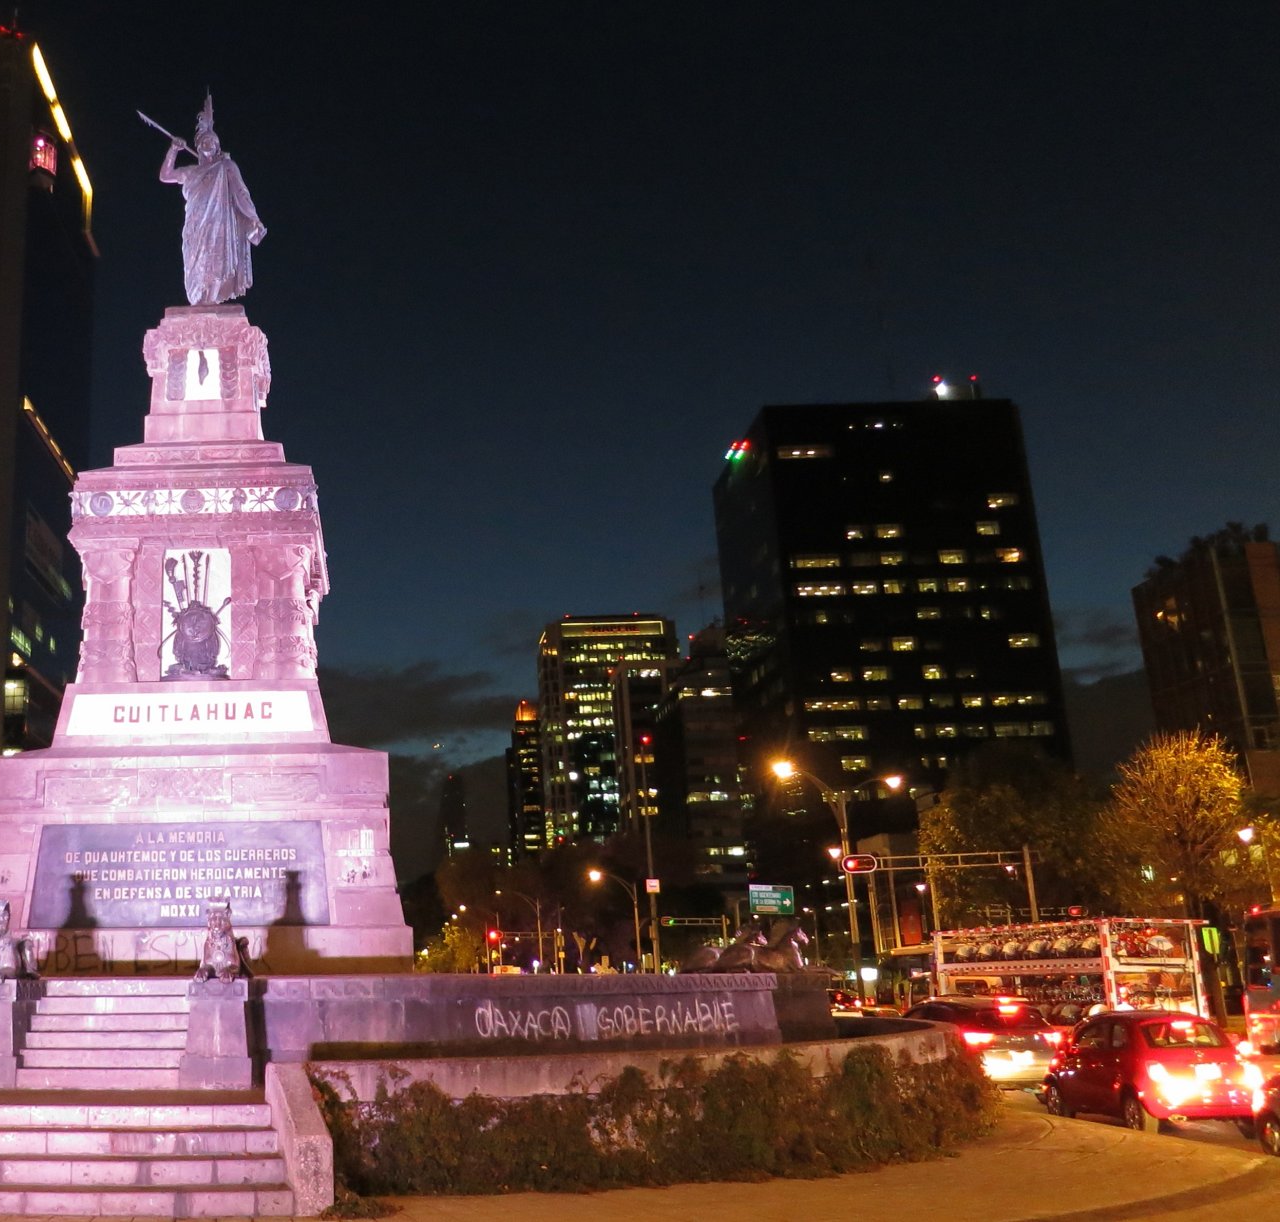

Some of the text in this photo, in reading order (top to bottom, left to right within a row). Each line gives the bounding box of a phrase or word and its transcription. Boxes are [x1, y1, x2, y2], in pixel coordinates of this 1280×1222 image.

[114, 701, 273, 723] CUITLAHUAC
[136, 831, 225, 844] A LA MEMORIA
[65, 849, 297, 864] DE QUAUHTEMOC Y DE LOS GUERREROS
[75, 867, 287, 881] QUE COMBATIERON HEROICAMENTE
[95, 886, 262, 900] EN DEFENSA DE SU PATRIA
[475, 999, 572, 1041] OAXACA
